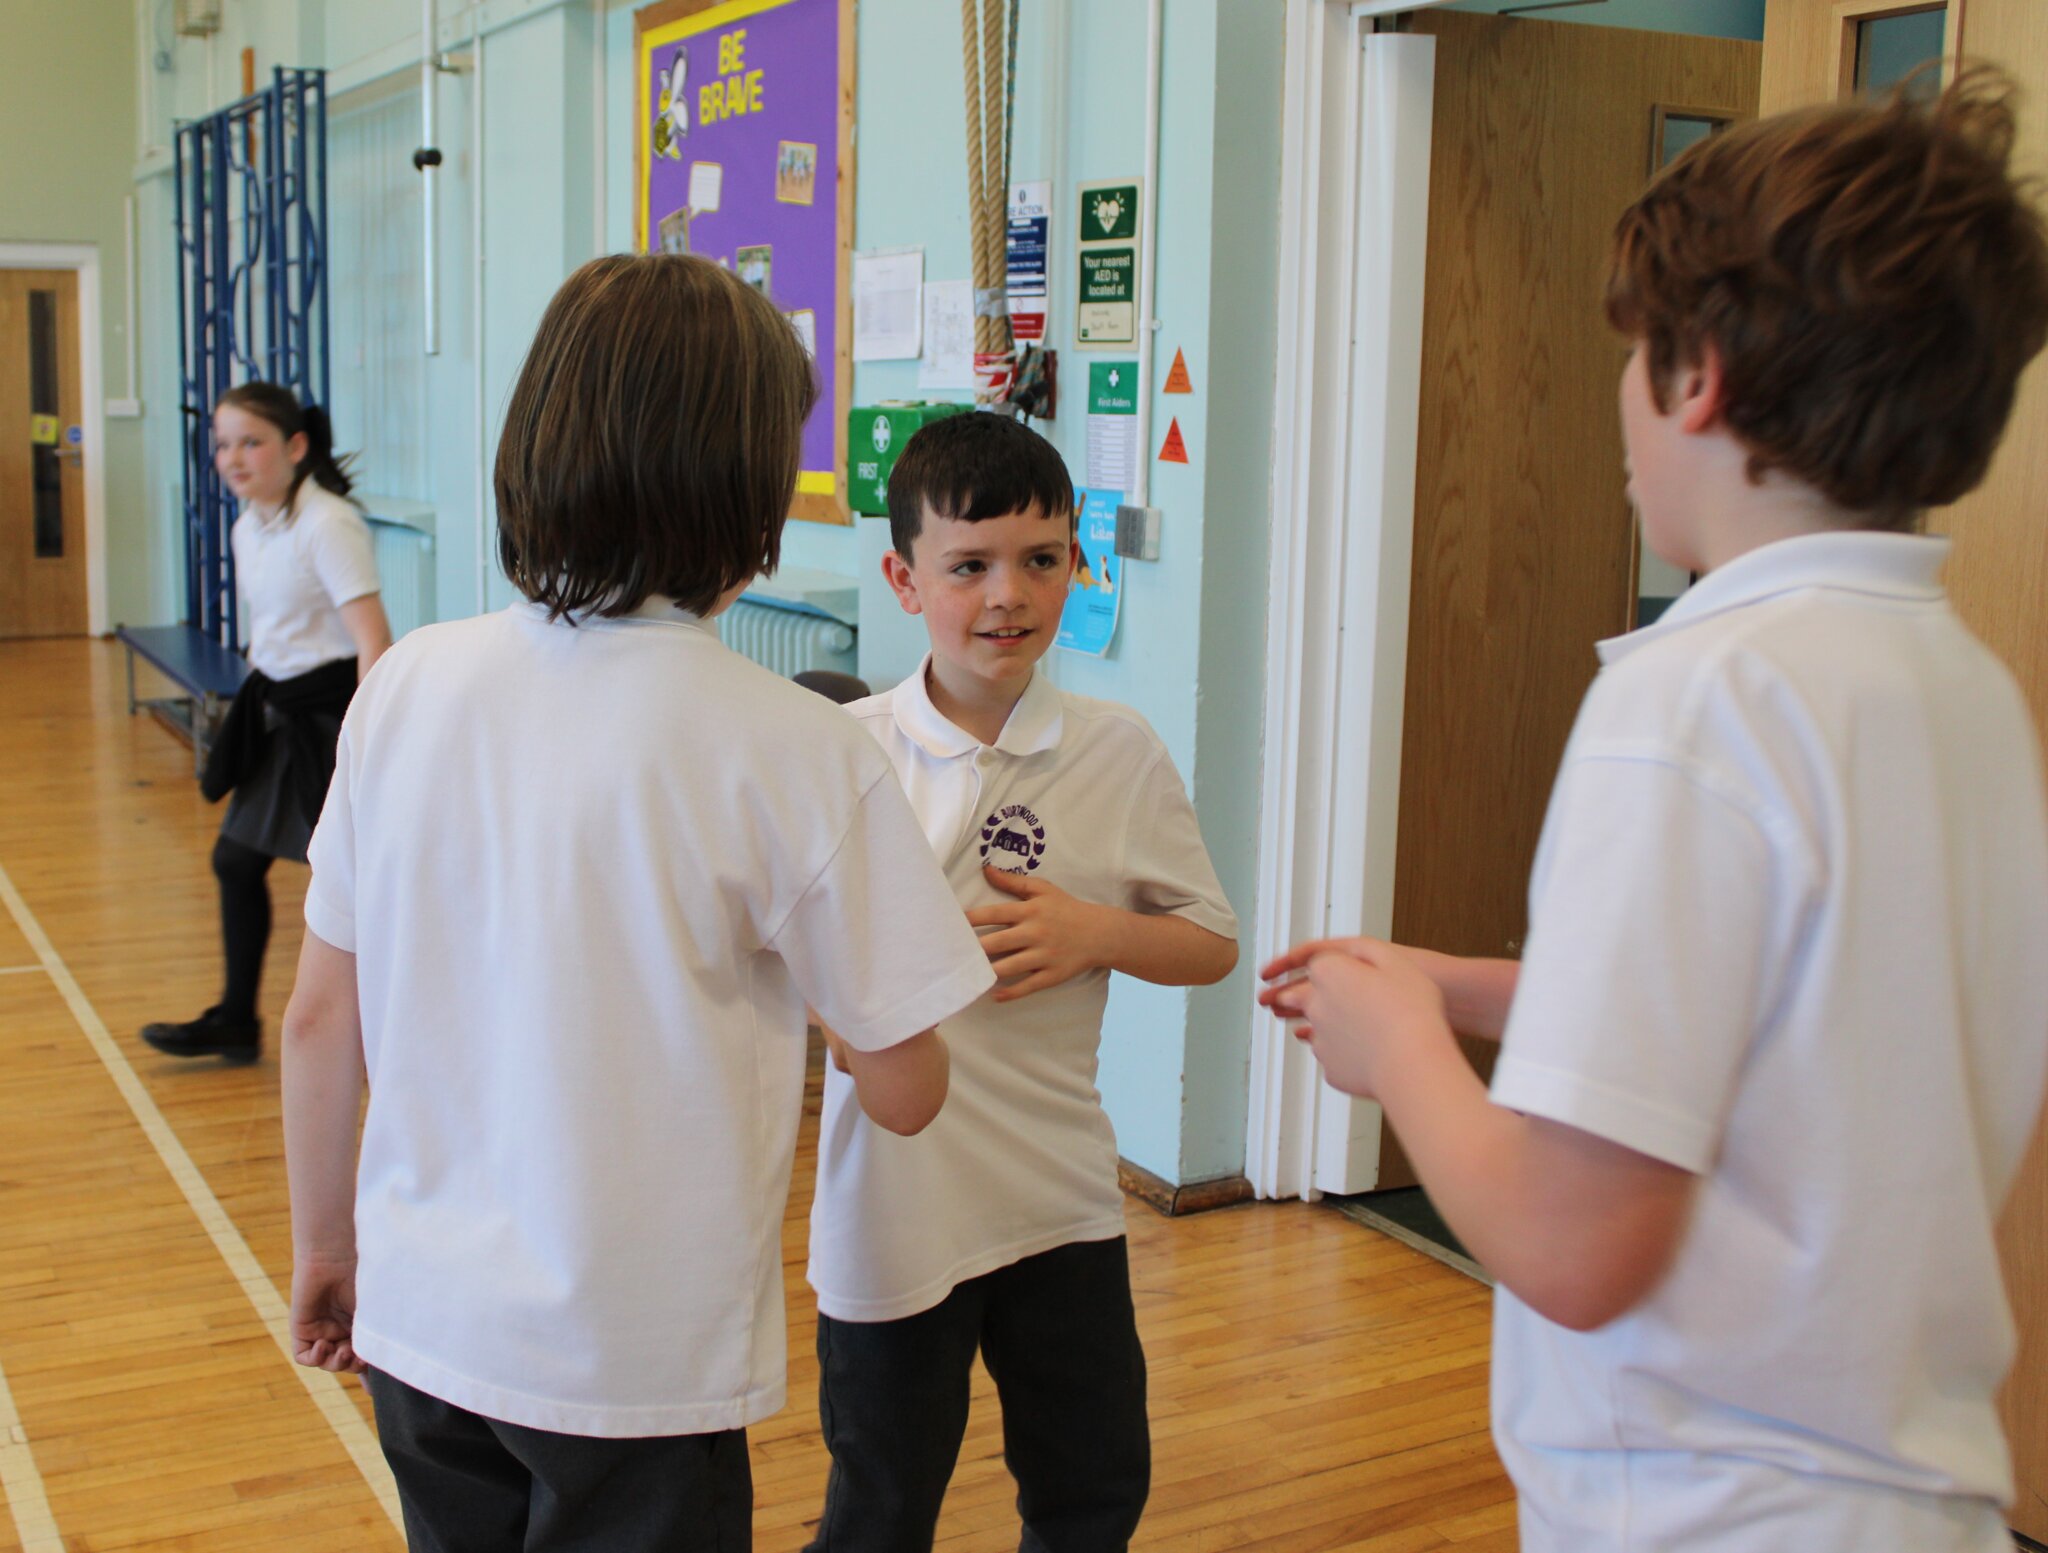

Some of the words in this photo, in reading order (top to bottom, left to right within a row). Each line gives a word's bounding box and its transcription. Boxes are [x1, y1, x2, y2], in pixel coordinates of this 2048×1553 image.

[719, 28, 747, 75] BE
[700, 68, 764, 126] BRAVE
[1083, 256, 1101, 268] Your
[1102, 255, 1131, 267] nearest
[1094, 269, 1111, 281] AED
[1113, 269, 1120, 281] is
[1088, 284, 1116, 296] located
[1117, 284, 1125, 296] at
[1098, 397, 1111, 408] First
[858, 462, 878, 480] FIRST
